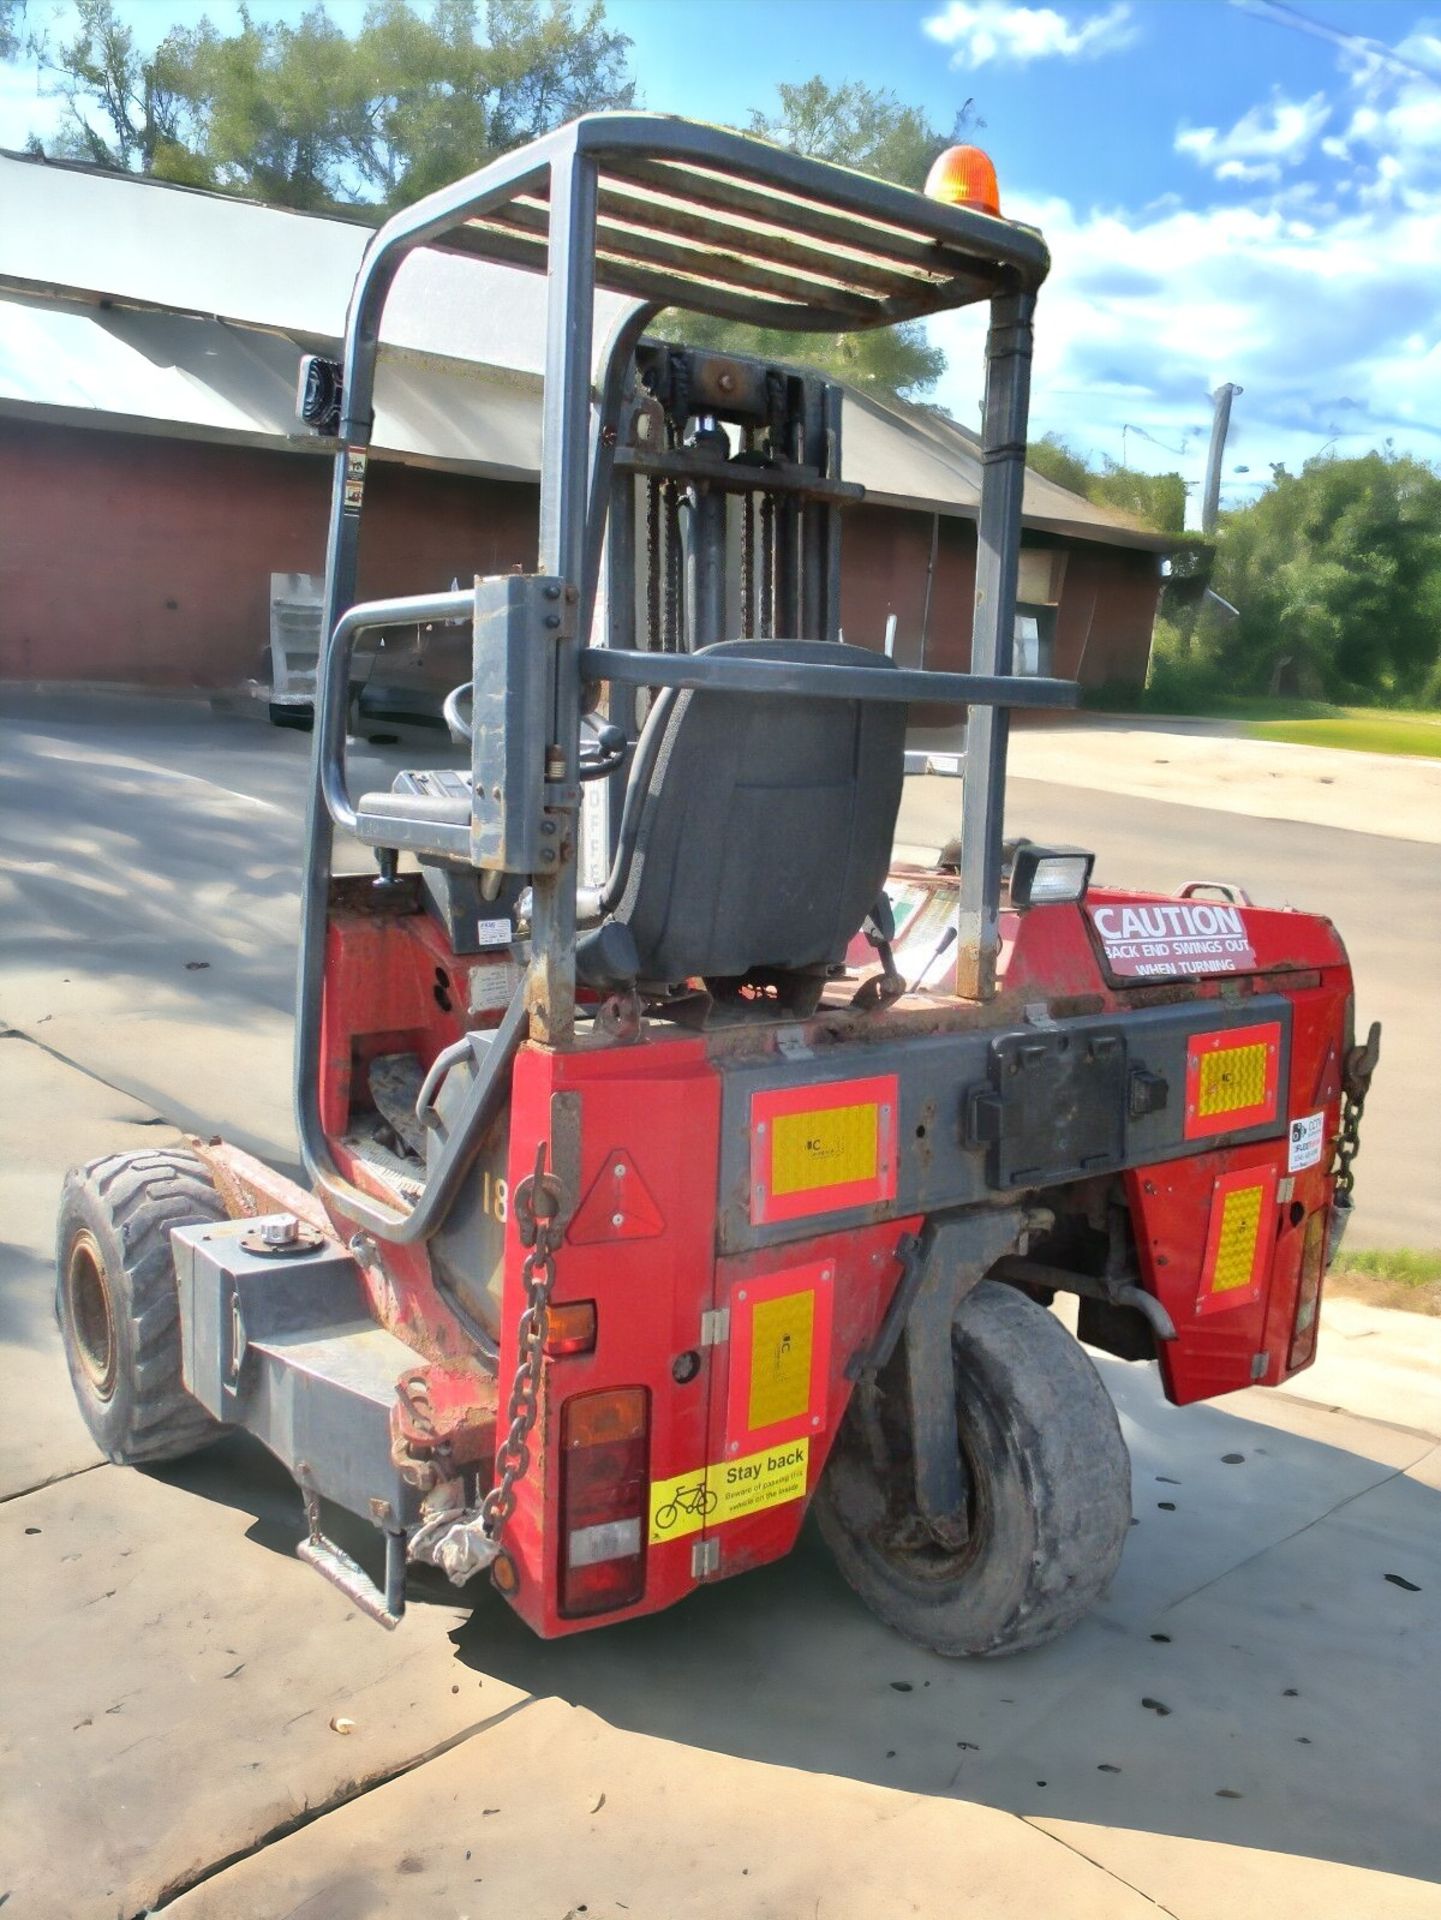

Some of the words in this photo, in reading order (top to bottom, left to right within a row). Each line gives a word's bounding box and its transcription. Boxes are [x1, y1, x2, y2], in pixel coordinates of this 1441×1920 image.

[1093, 905, 1243, 940] CAUTION
[1104, 944, 1140, 959] BACK
[1143, 942, 1170, 957] END
[1174, 939, 1222, 955] SWINGS
[1225, 938, 1250, 952] OUT
[1135, 962, 1176, 976] WHEN
[1178, 958, 1236, 974] TURNING
[727, 1463, 762, 1484] Stay
[767, 1448, 804, 1471] back
